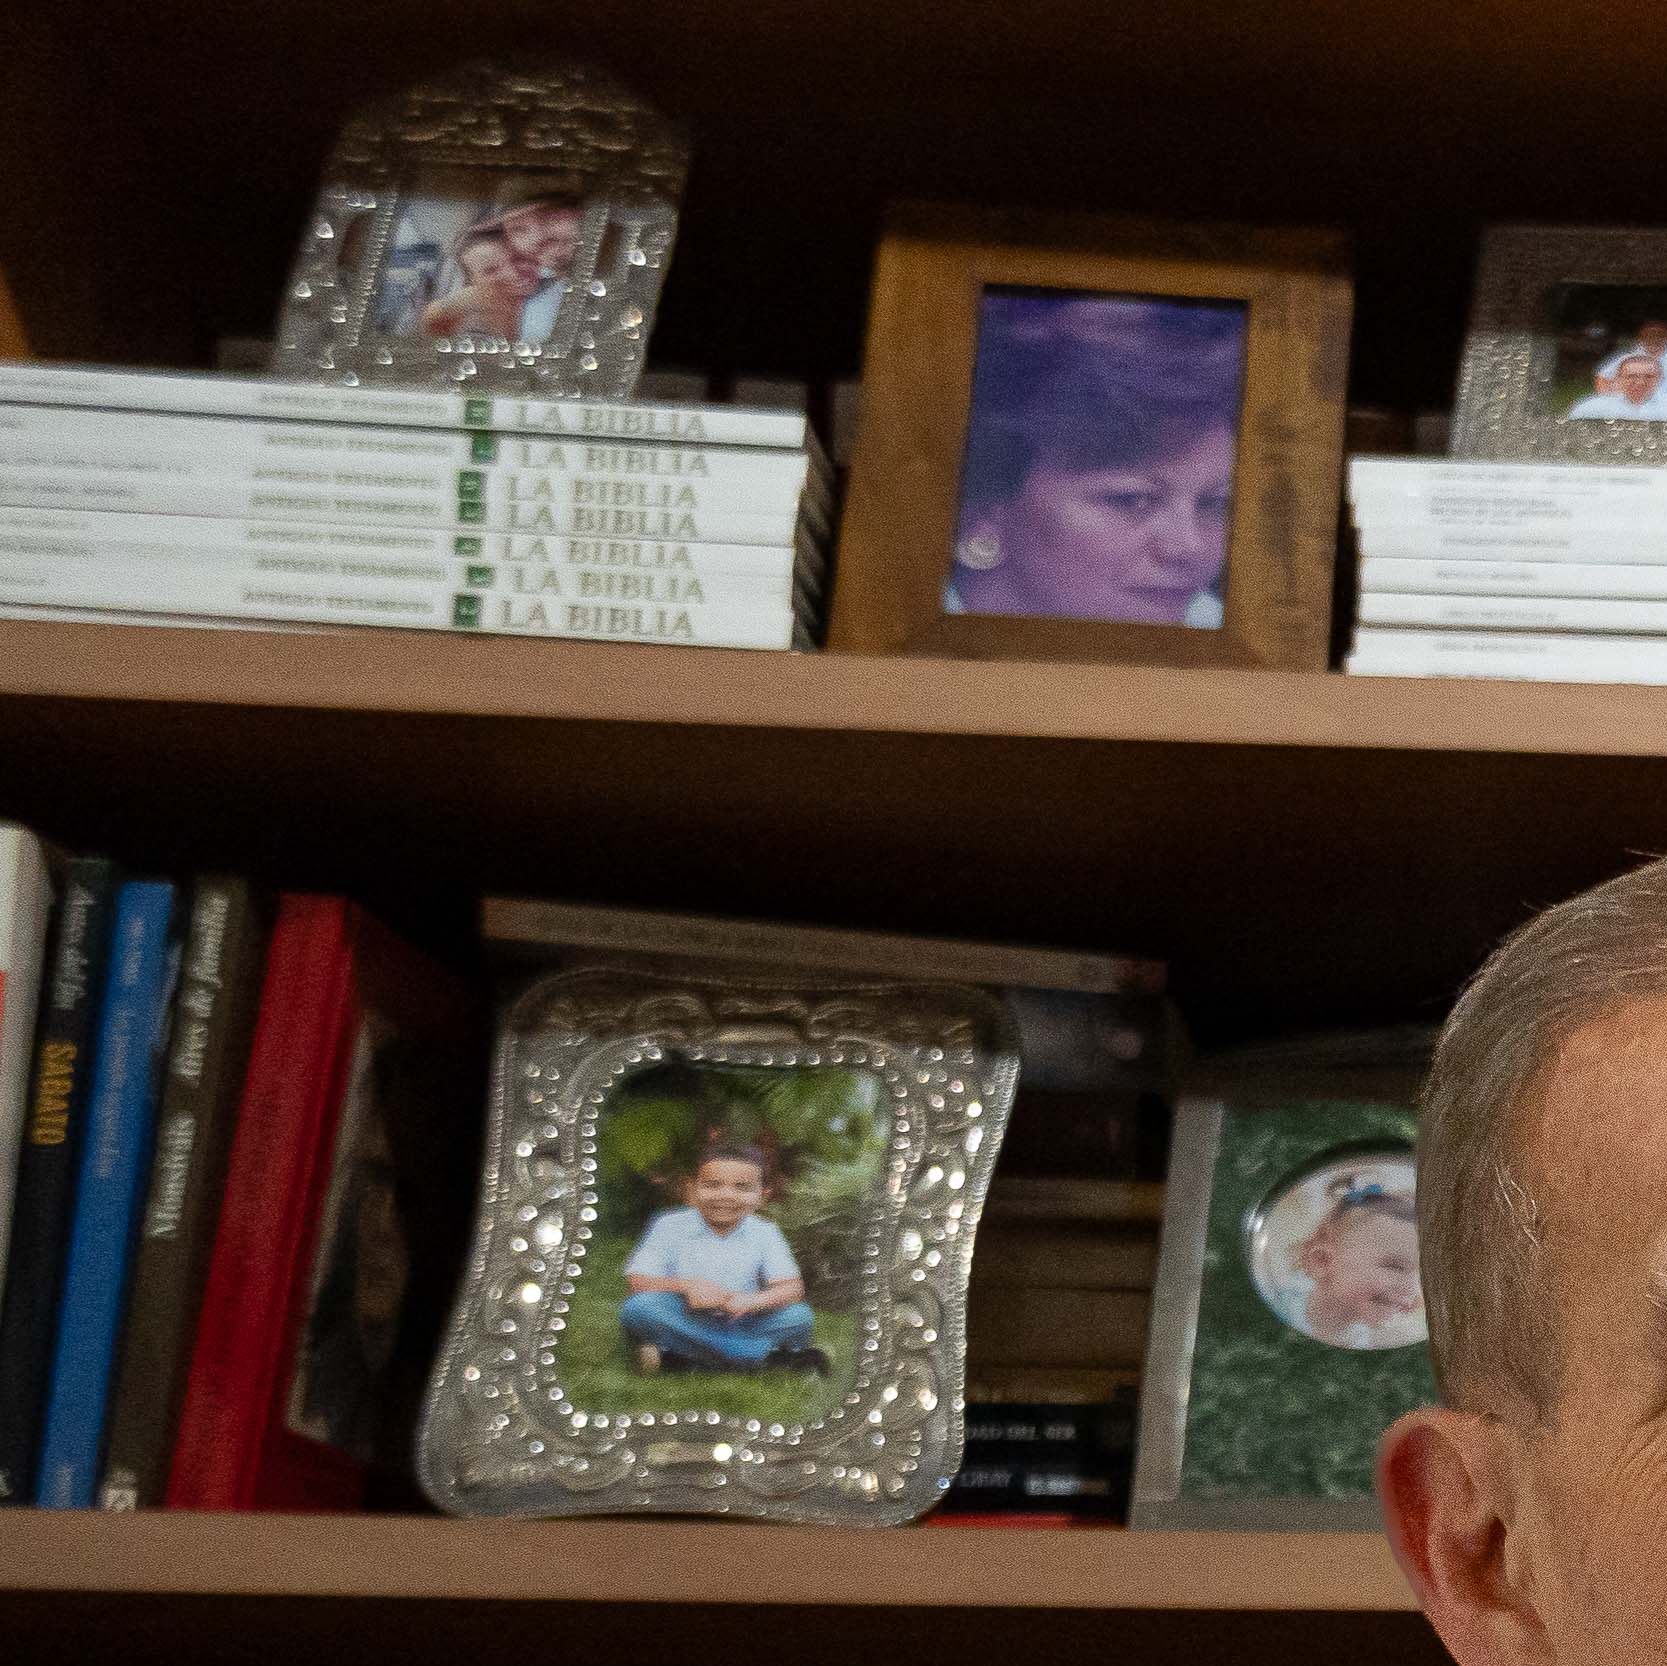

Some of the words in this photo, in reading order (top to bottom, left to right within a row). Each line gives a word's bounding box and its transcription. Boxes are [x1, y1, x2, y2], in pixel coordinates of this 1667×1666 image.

[518, 405, 565, 430] LA
[582, 408, 707, 439] BIBLIA
[522, 445, 567, 469] LA
[586, 449, 710, 476] BIBLIA
[509, 476, 555, 503] LA
[574, 480, 698, 509] BIBLIA
[508, 504, 556, 530] LA
[574, 508, 699, 537] BIBLIA
[504, 537, 549, 562] LA
[569, 541, 693, 570] BIBLIA
[514, 566, 562, 594] LA
[580, 572, 705, 603] BIBLIA
[502, 600, 550, 628] LA
[569, 605, 695, 637] BIBLIA
[31, 1042, 79, 1145] SABATO
